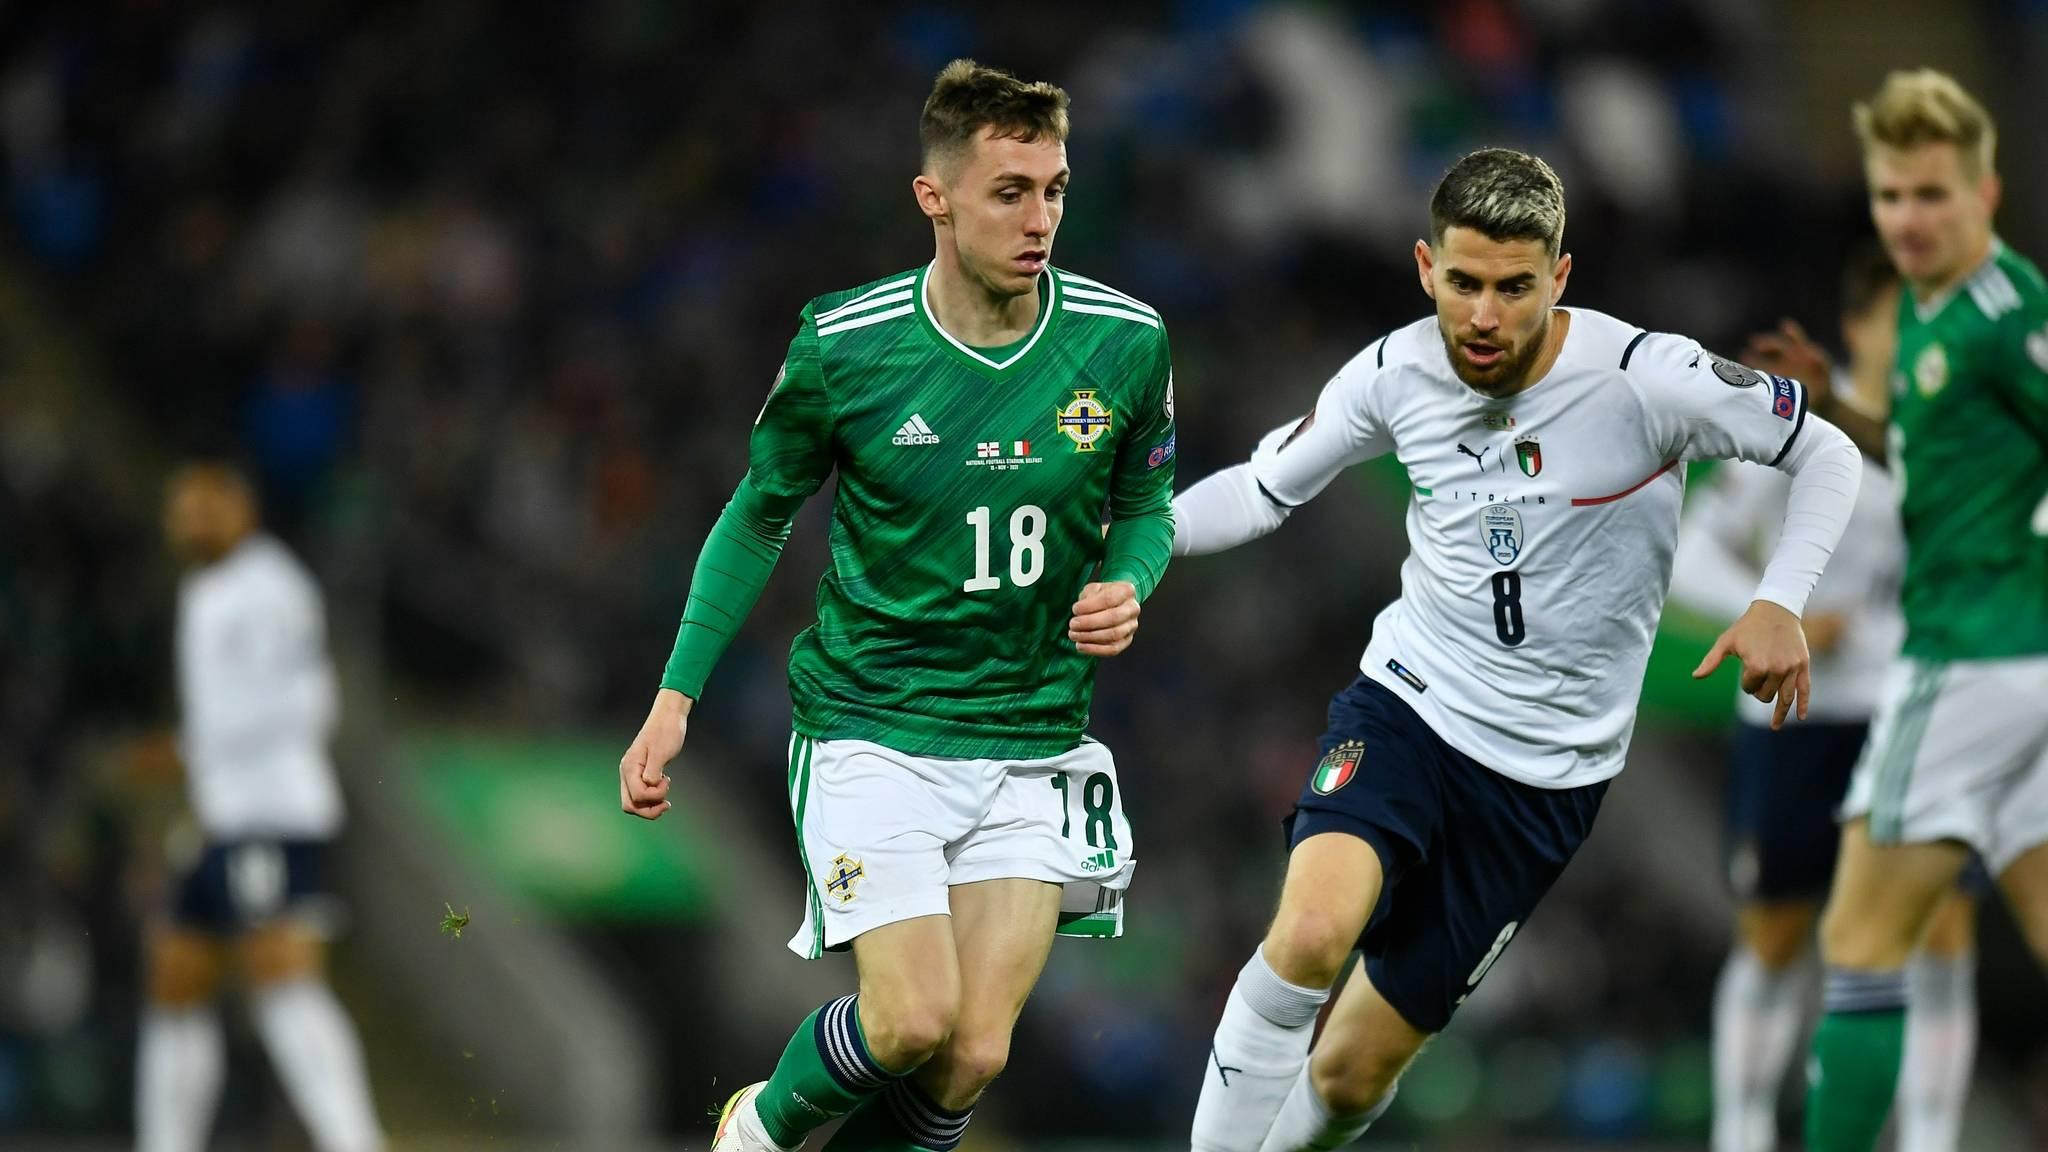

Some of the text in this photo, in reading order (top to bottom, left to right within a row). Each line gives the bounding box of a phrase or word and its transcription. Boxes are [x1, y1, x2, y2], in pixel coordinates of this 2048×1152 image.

[891, 433, 940, 446] adidas
[964, 505, 1046, 592] 18
[1492, 571, 1525, 646] 8
[1050, 771, 1118, 851] 18
[1467, 920, 1519, 987] 8
